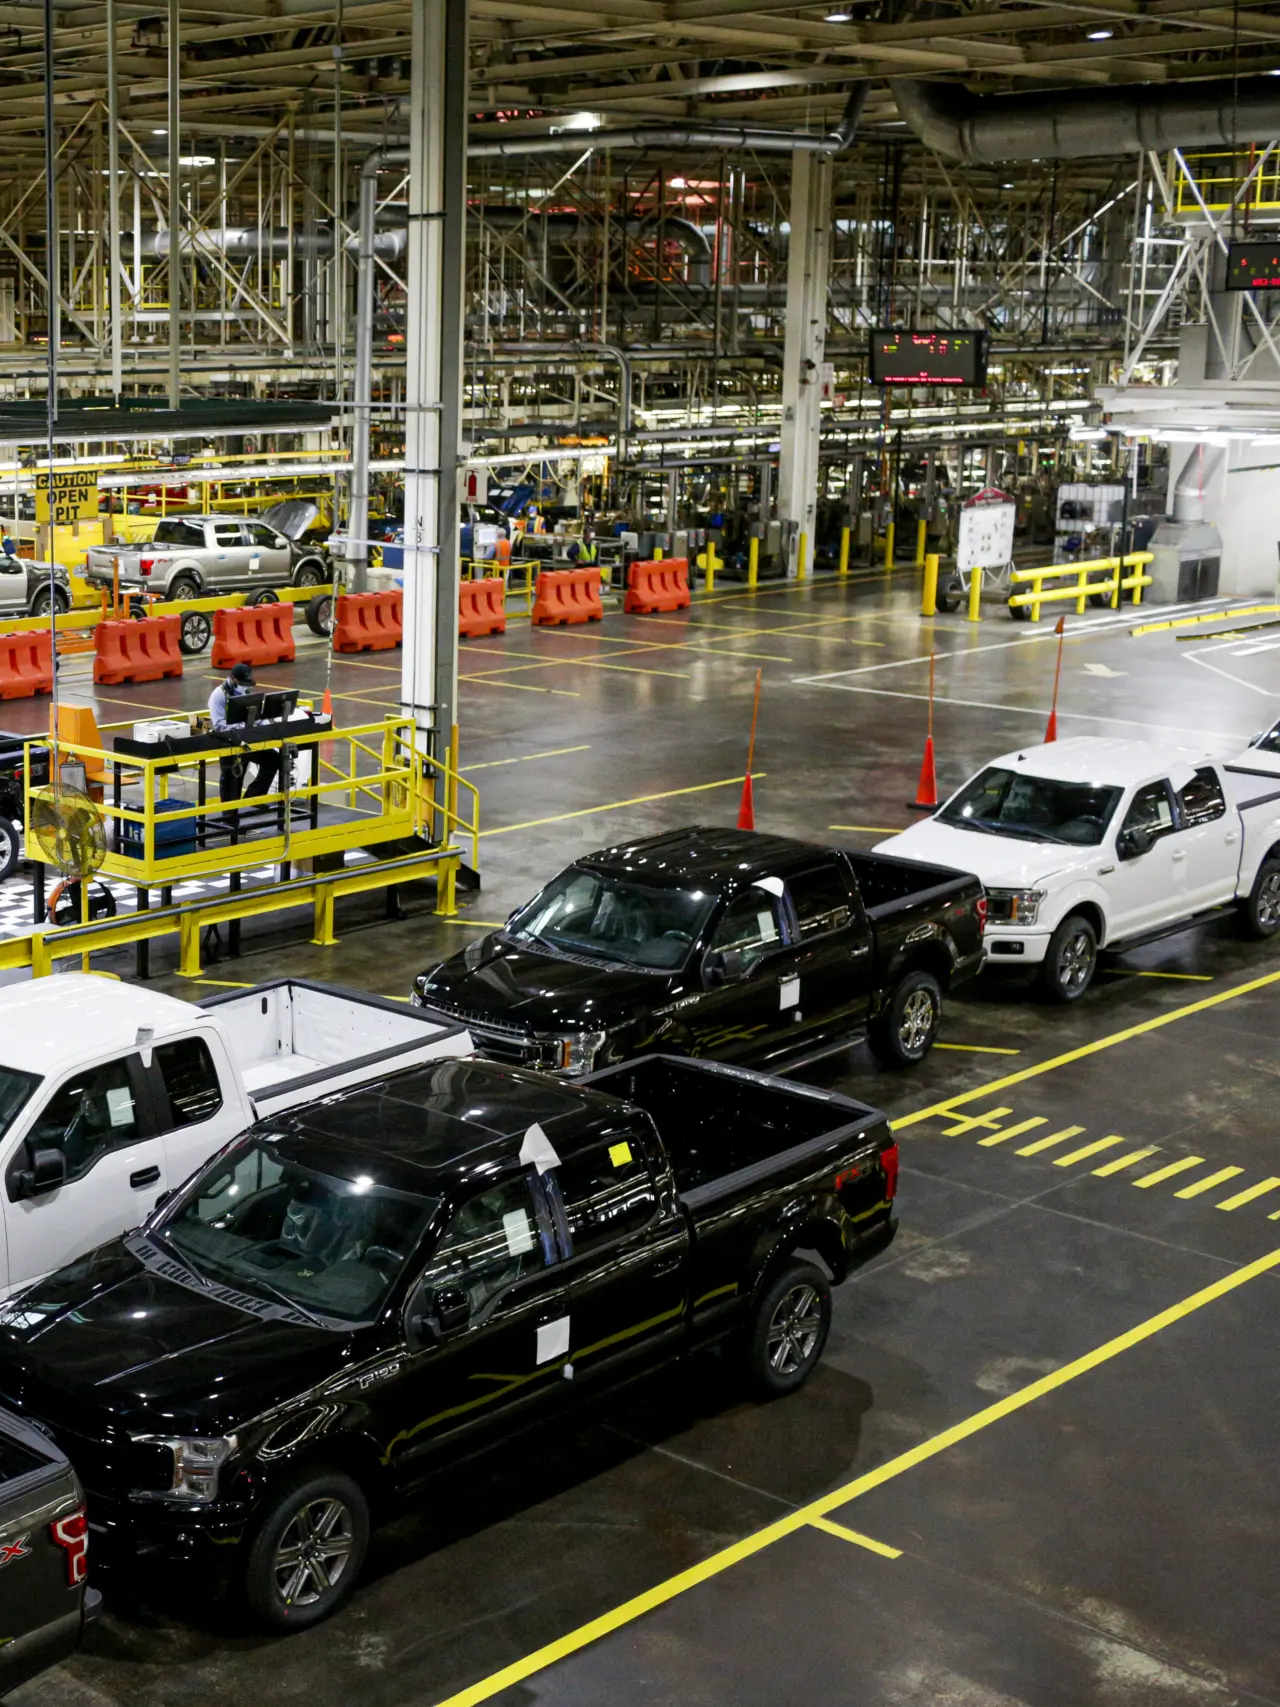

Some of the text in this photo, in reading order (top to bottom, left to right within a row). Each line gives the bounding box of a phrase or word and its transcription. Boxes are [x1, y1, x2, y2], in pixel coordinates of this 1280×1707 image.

[38, 472, 96, 487] CAUTION
[46, 488, 89, 505] OPEN
[56, 505, 80, 520] PIT
